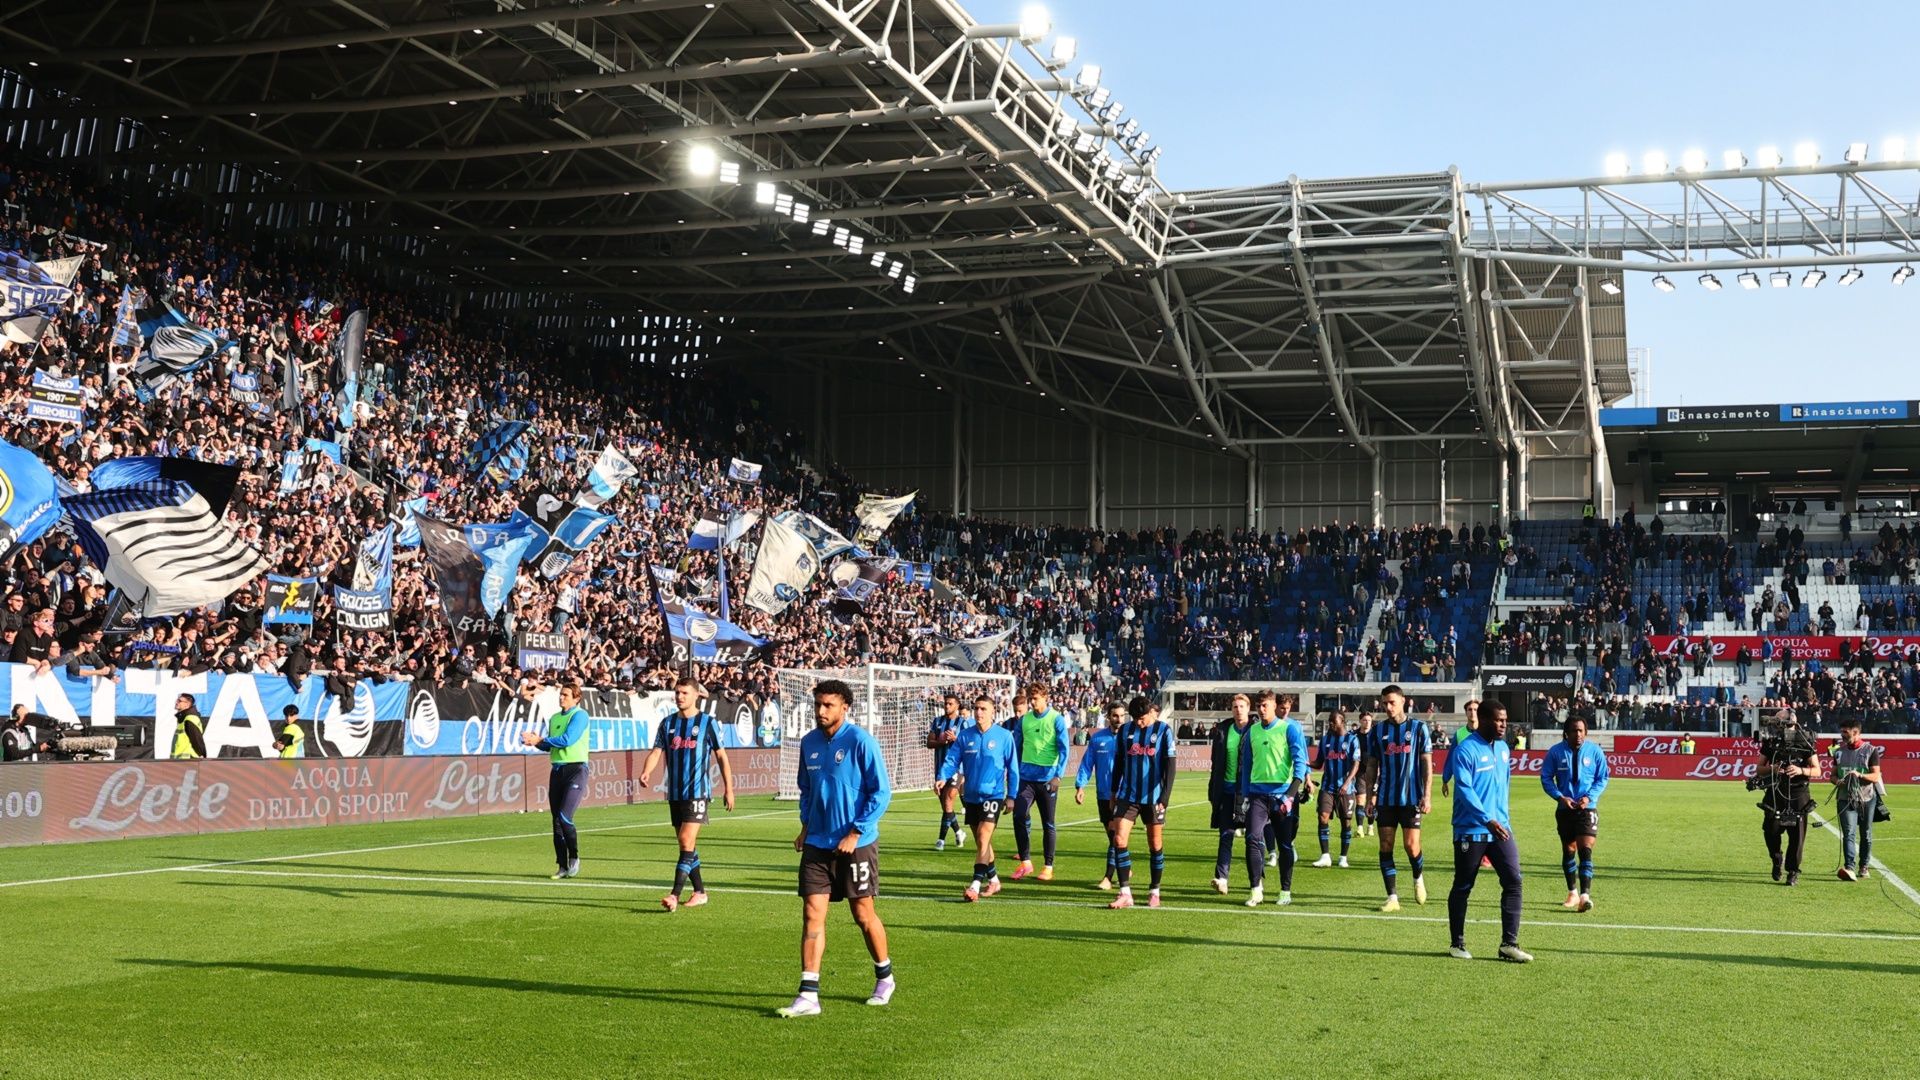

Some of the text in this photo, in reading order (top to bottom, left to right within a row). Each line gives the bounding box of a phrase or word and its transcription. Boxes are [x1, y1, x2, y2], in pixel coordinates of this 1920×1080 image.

[46, 392, 66, 402] 1907
[32, 405, 77, 419] NEROBLU
[1669, 409, 1770, 420] Rinascimento
[1793, 405, 1897, 417] Rinascimento
[525, 633, 565, 649] PER CHI
[1658, 636, 1726, 656] Lee
[583, 688, 633, 718] ORZA
[1629, 737, 1683, 754] Let
[588, 758, 618, 779] QUA
[749, 753, 780, 771] ACQU
[1510, 752, 1543, 771] ete
[1607, 755, 1637, 766] QUA
[1686, 756, 1758, 778] Lete
[291, 766, 373, 793] ACQUA
[1615, 766, 1659, 777] SPORT
[424, 760, 522, 810] Lete
[595, 779, 641, 799] SPORT
[68, 766, 230, 831] Lete
[248, 792, 409, 821] DELLO SPORT
[692, 800, 706, 813] 19
[983, 800, 999, 813] 90
[850, 861, 870, 882] 13
